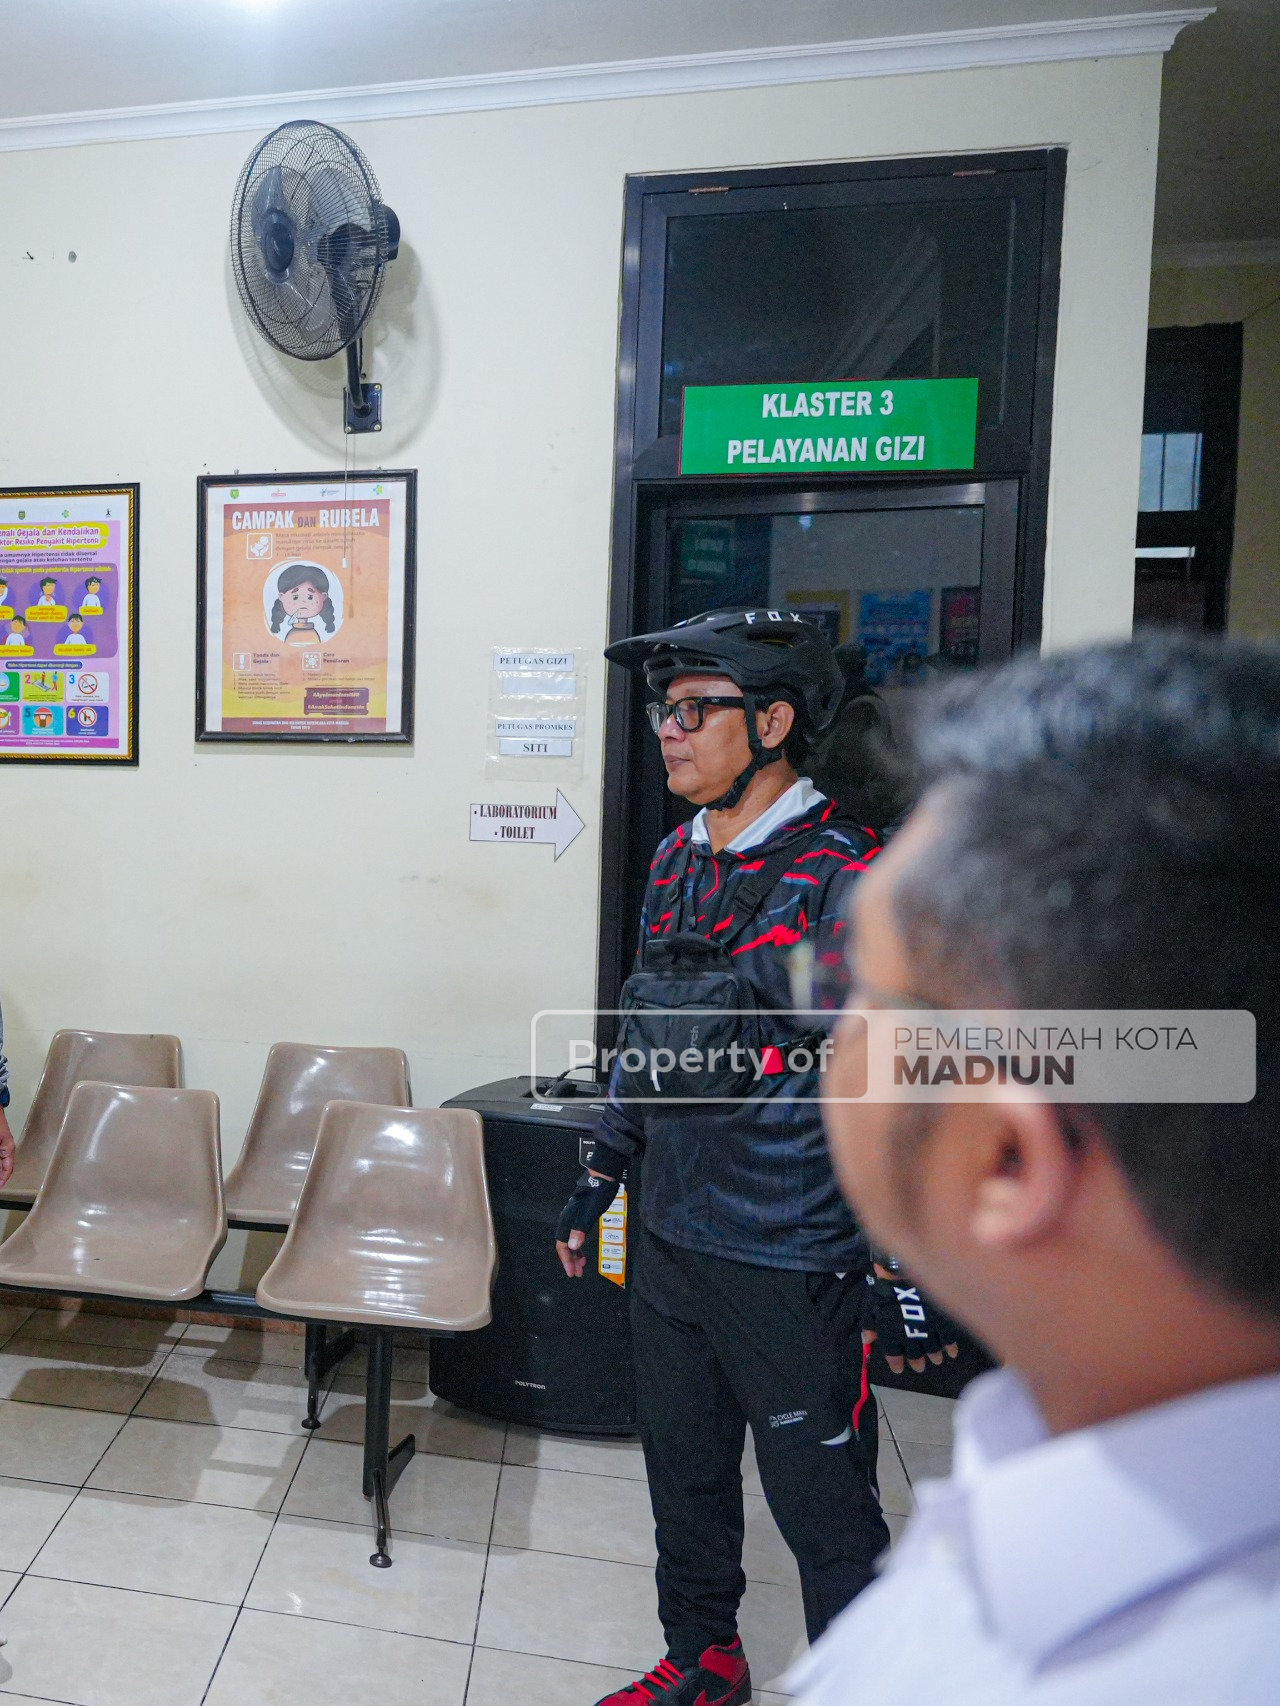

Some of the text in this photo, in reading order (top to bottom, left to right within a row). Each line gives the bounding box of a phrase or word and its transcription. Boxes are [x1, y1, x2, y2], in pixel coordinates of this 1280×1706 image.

[762, 390, 894, 418] KLASTER 3
[727, 436, 925, 464] PELAYANAN GIZI
[232, 507, 380, 530] CAMPAK DAN RUBELA
[17, 528, 40, 539] Gejala
[42, 528, 55, 536] dan
[57, 527, 99, 536] Kendalikan
[15, 538, 35, 546] Resiko
[36, 538, 65, 547] Penyakit
[67, 537, 99, 546] Hipertensi
[744, 611, 803, 625] FOX
[500, 657, 568, 665] PETUGAS GIZI
[24, 674, 31, 684] 2
[69, 674, 75, 684] 3
[24, 706, 31, 718] 5
[68, 707, 76, 719] 6
[498, 723, 573, 731] PETUGAS PROMKES
[523, 743, 548, 752] SITI
[480, 805, 557, 820] LABORATORIUM
[500, 826, 536, 839] TOILET
[893, 1286, 929, 1338] FOX
[514, 1380, 546, 1390] POLYTRON
